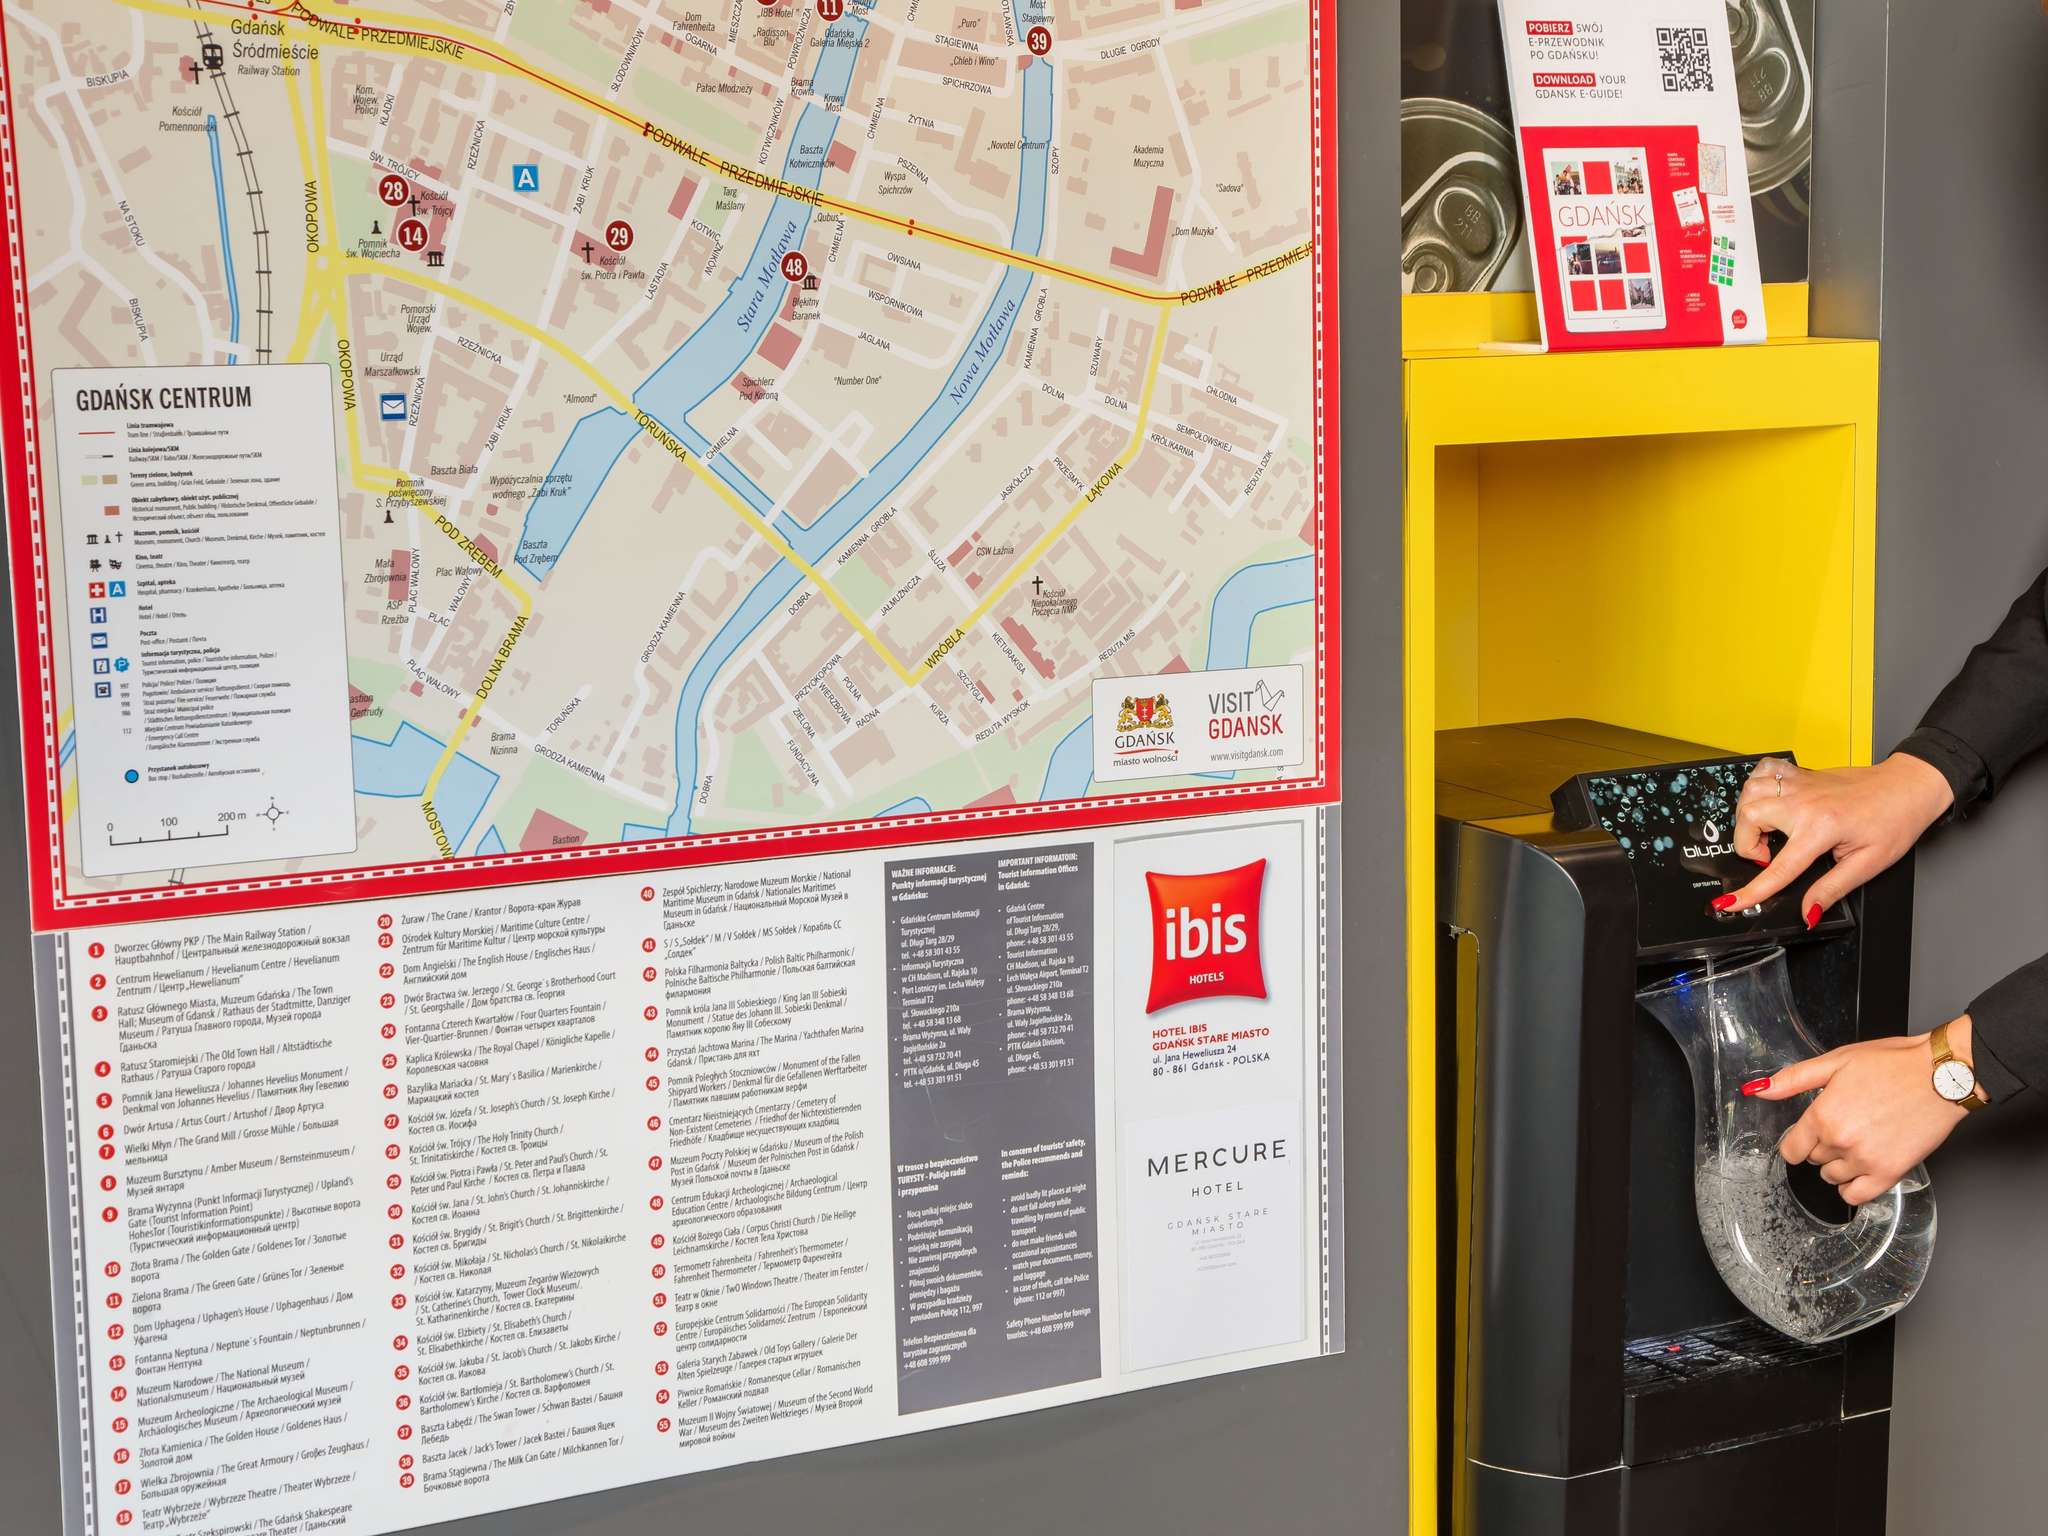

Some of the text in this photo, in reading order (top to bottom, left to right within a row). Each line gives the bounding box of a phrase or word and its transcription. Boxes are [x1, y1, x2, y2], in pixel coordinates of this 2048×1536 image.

[231, 19, 286, 37] Gdańsk
[291, 3, 465, 59] PODWALE PRZEDMIEJSKIE
[1529, 22, 1603, 33] POBIERZ SWÓJ
[232, 41, 319, 60] Śródmieście
[685, 33, 718, 56] OGARNA
[935, 35, 979, 52] STĄGIEWNA
[1032, 33, 1046, 50] 39
[1100, 38, 1160, 60] DŁUGIE OGRODY
[1529, 38, 1604, 47] E-PRZEWODNIK
[610, 28, 646, 92] SŁODOWNIKÓW
[1530, 49, 1599, 60] PO GDAŃSKU!
[85, 69, 130, 88] BISKUPIA
[237, 64, 301, 78] Railway Station
[1536, 75, 1625, 84] DOWNLOAD YOUR
[942, 77, 992, 94] SPICHRZOWA
[1536, 89, 1622, 98] GDANSK E-GUIDE!
[379, 95, 395, 126] KŁADKI
[867, 96, 886, 140] CHMIELNA
[908, 114, 934, 128] ŻYTNIA
[759, 98, 784, 165] KOTWICZNIKÓW
[467, 120, 486, 170] RZEŹNICKA
[646, 124, 710, 166] PODWALE
[800, 145, 823, 154] Baszta
[1134, 145, 1164, 154] Akademia
[369, 151, 421, 181] ŚW. TRÓJCY
[1052, 147, 1060, 174] SZOPY
[1134, 158, 1164, 168] Muzyczna
[518, 168, 535, 188] A
[884, 172, 906, 182] Wyspa
[897, 157, 929, 184] PSZENNA
[384, 182, 403, 200] 28
[574, 166, 595, 214] ŻABI KRUK
[720, 162, 824, 206] PRZEDMIEJSKIE
[878, 185, 912, 195] Spichrzów
[306, 180, 318, 253] OKOPOWA
[1559, 201, 1647, 227] GDAŃSK
[358, 238, 388, 249] Pomnik
[403, 226, 423, 245] 14
[610, 227, 628, 245] 29
[346, 247, 400, 259] św. Wojciecha
[737, 221, 798, 332] Stara Motława
[786, 258, 802, 276] 48
[1180, 274, 1238, 306] PODWALE
[400, 304, 436, 314] Pomorski
[792, 297, 820, 308] Błękitny
[868, 290, 923, 318] WSPORNIKOWA
[408, 314, 430, 324] Urząd
[792, 311, 820, 320] Baranek
[457, 336, 502, 364] RZEŹNICKA
[950, 298, 1016, 405] Nowa Motława
[1090, 336, 1103, 376] SZUWARY
[338, 339, 356, 411] OKOPOWA
[364, 366, 420, 377] Marszałkowski
[76, 384, 252, 411] GDAŃSK CENTRUM
[1206, 385, 1238, 405] CHŁODNA
[634, 409, 688, 462] TORUŃSKA
[705, 426, 739, 460] CHMIELNA
[1150, 432, 1194, 458] KRÓLIKARNIA
[1176, 423, 1233, 453] SEMPOŁOWSKIEJ
[431, 465, 478, 475] Baszta Biała
[1086, 463, 1124, 503] ŁĄKOWA
[434, 515, 503, 578] POD ZRĘBEM
[640, 591, 685, 664] GRODZA KAMIENNA
[476, 614, 528, 700] DOLNA BRAMA
[923, 628, 965, 670] WRÓBLA
[1209, 691, 1253, 714] VISIT
[929, 702, 949, 727] KURZA
[490, 730, 516, 742] Brama
[1209, 714, 1283, 739] GDANSK
[1115, 731, 1175, 748] GDAŃSK
[1113, 754, 1178, 766] miasto wolności
[1211, 748, 1284, 761] www.visitgdansk.com
[161, 817, 178, 827] 100
[218, 812, 236, 821] 200
[107, 823, 113, 832] 0
[998, 856, 1034, 868] IMPORTANT
[892, 865, 956, 879] WAŻNE INFORMACJE:
[402, 905, 501, 925] Żuraw The Crane Krantor
[1166, 903, 1247, 960] ibis
[114, 936, 200, 953] Dworzec Główny PKP
[1190, 972, 1224, 984] HOTELS
[761, 1033, 798, 1045] The Marina
[1152, 1024, 1207, 1038] HOTEL IBIS
[1152, 1028, 1269, 1050] GDAŃSK STARE MIASTO
[121, 1045, 275, 1072] Ratusz Staromiejski The Old Town Hall
[1164, 1053, 1180, 1064] Jana
[1182, 1047, 1225, 1060] Heweliusza
[1227, 1045, 1236, 1053] 24
[1153, 1068, 1163, 1076] 80
[1173, 1064, 1187, 1073] 861
[1233, 1053, 1270, 1065] POLSKA
[1148, 1140, 1286, 1177] MERCURE
[1192, 1181, 1243, 1197] HOTEL
[1228, 1208, 1268, 1220] STARE
[1192, 1222, 1243, 1235] MIASTO
[742, 1279, 772, 1292] Windows
[774, 1274, 798, 1287] Theatre
[210, 1426, 279, 1445] The Golden House
[422, 1447, 468, 1464] Baszta Jacek
